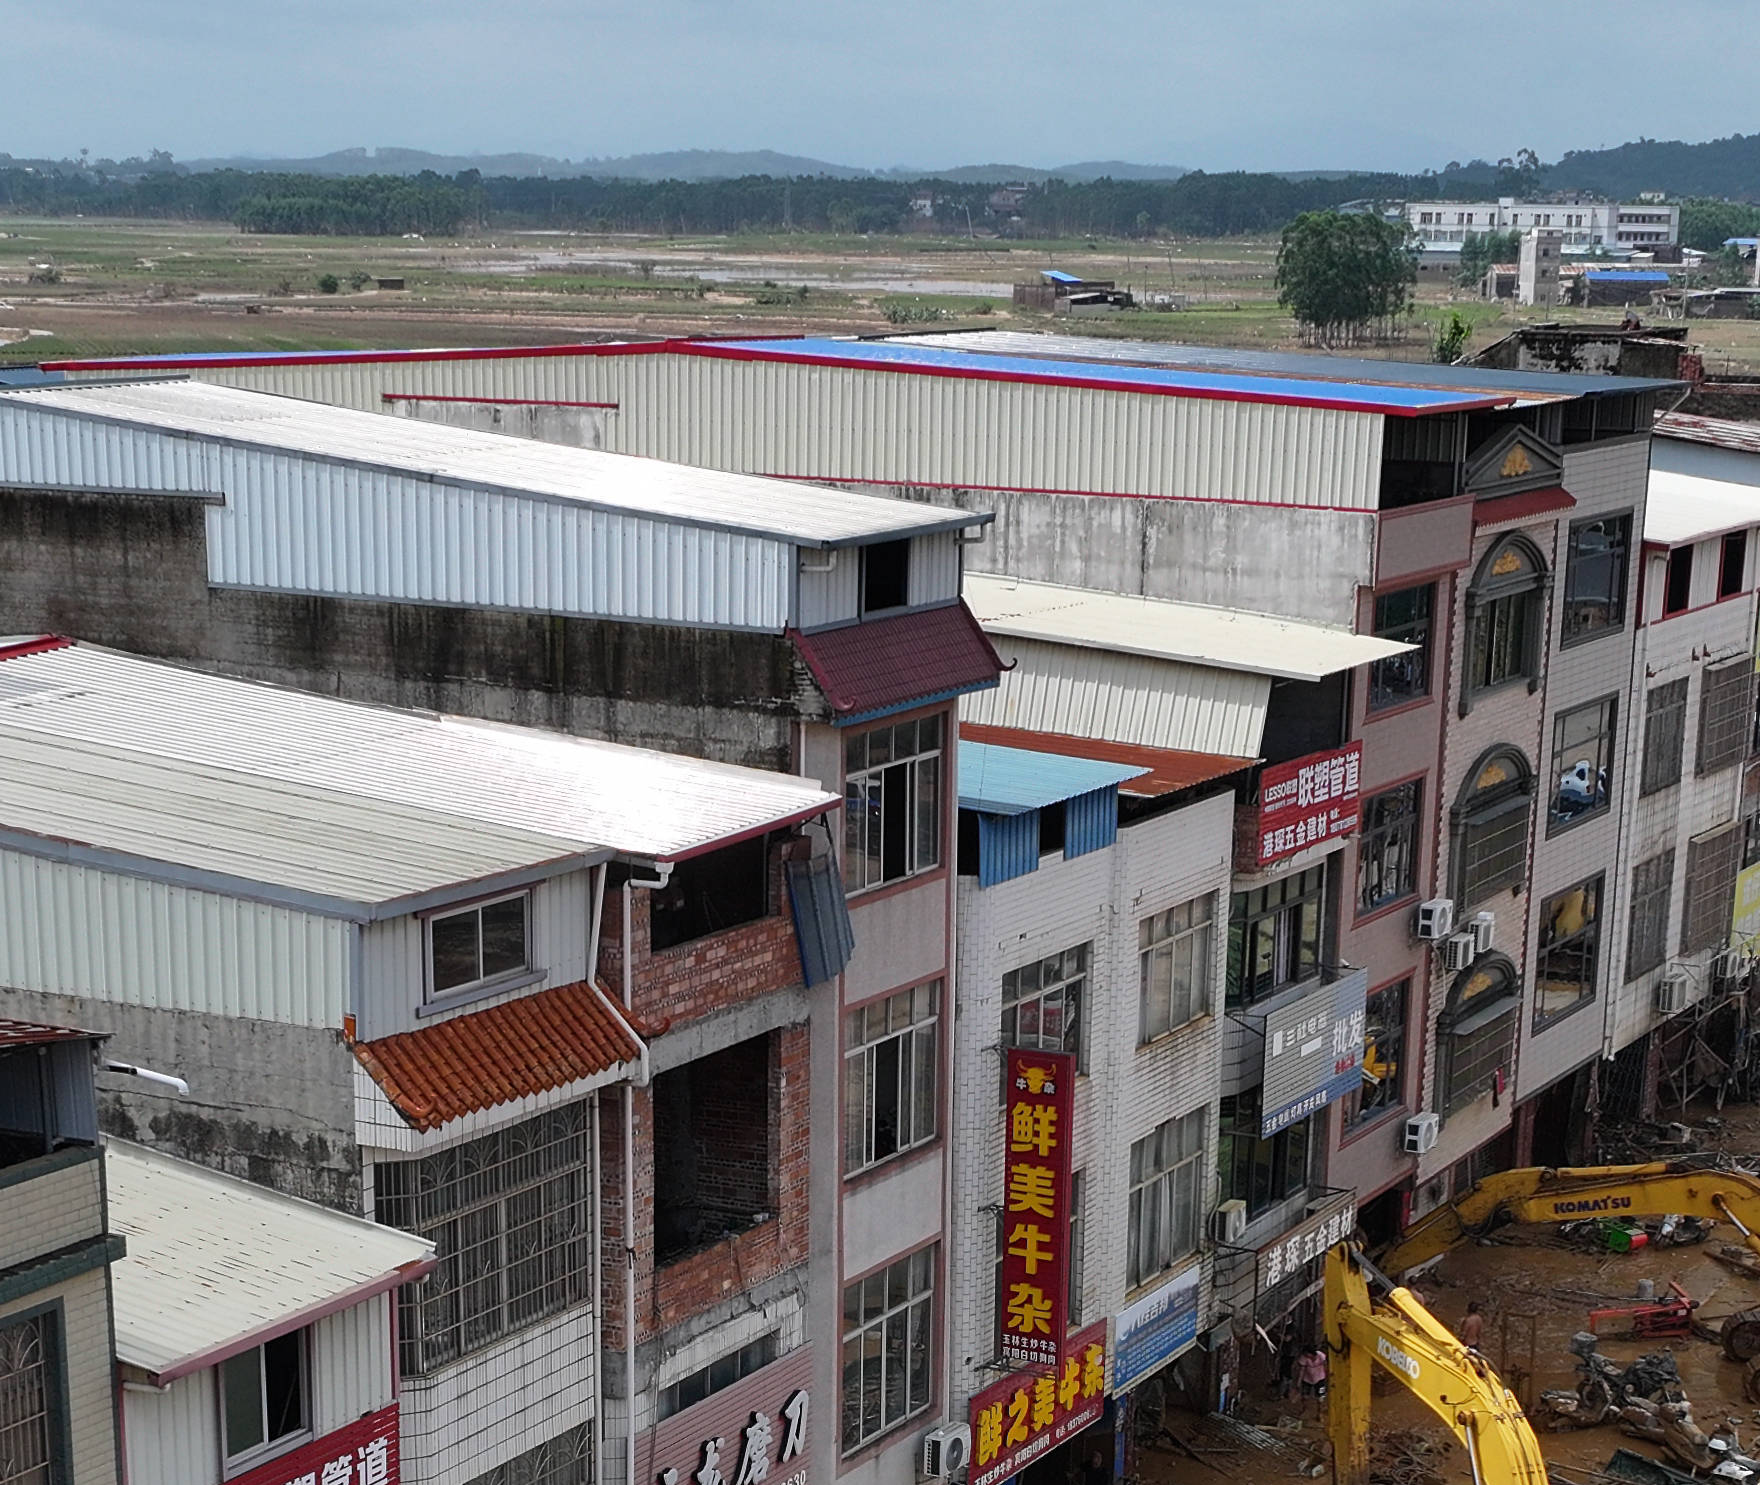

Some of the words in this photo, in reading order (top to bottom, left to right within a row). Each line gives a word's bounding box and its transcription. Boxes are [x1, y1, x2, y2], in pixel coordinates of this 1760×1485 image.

[1297, 751, 1360, 808] 联塑管道
[1332, 1009, 1364, 1057] 批发
[1006, 1101, 1059, 1335] 鲜美牛杂
[1552, 1195, 1632, 1214] KOMATSU
[1002, 1333, 1057, 1353] 玉林生炒牛杂
[976, 1343, 1105, 1467] 鲜之美牛杂
